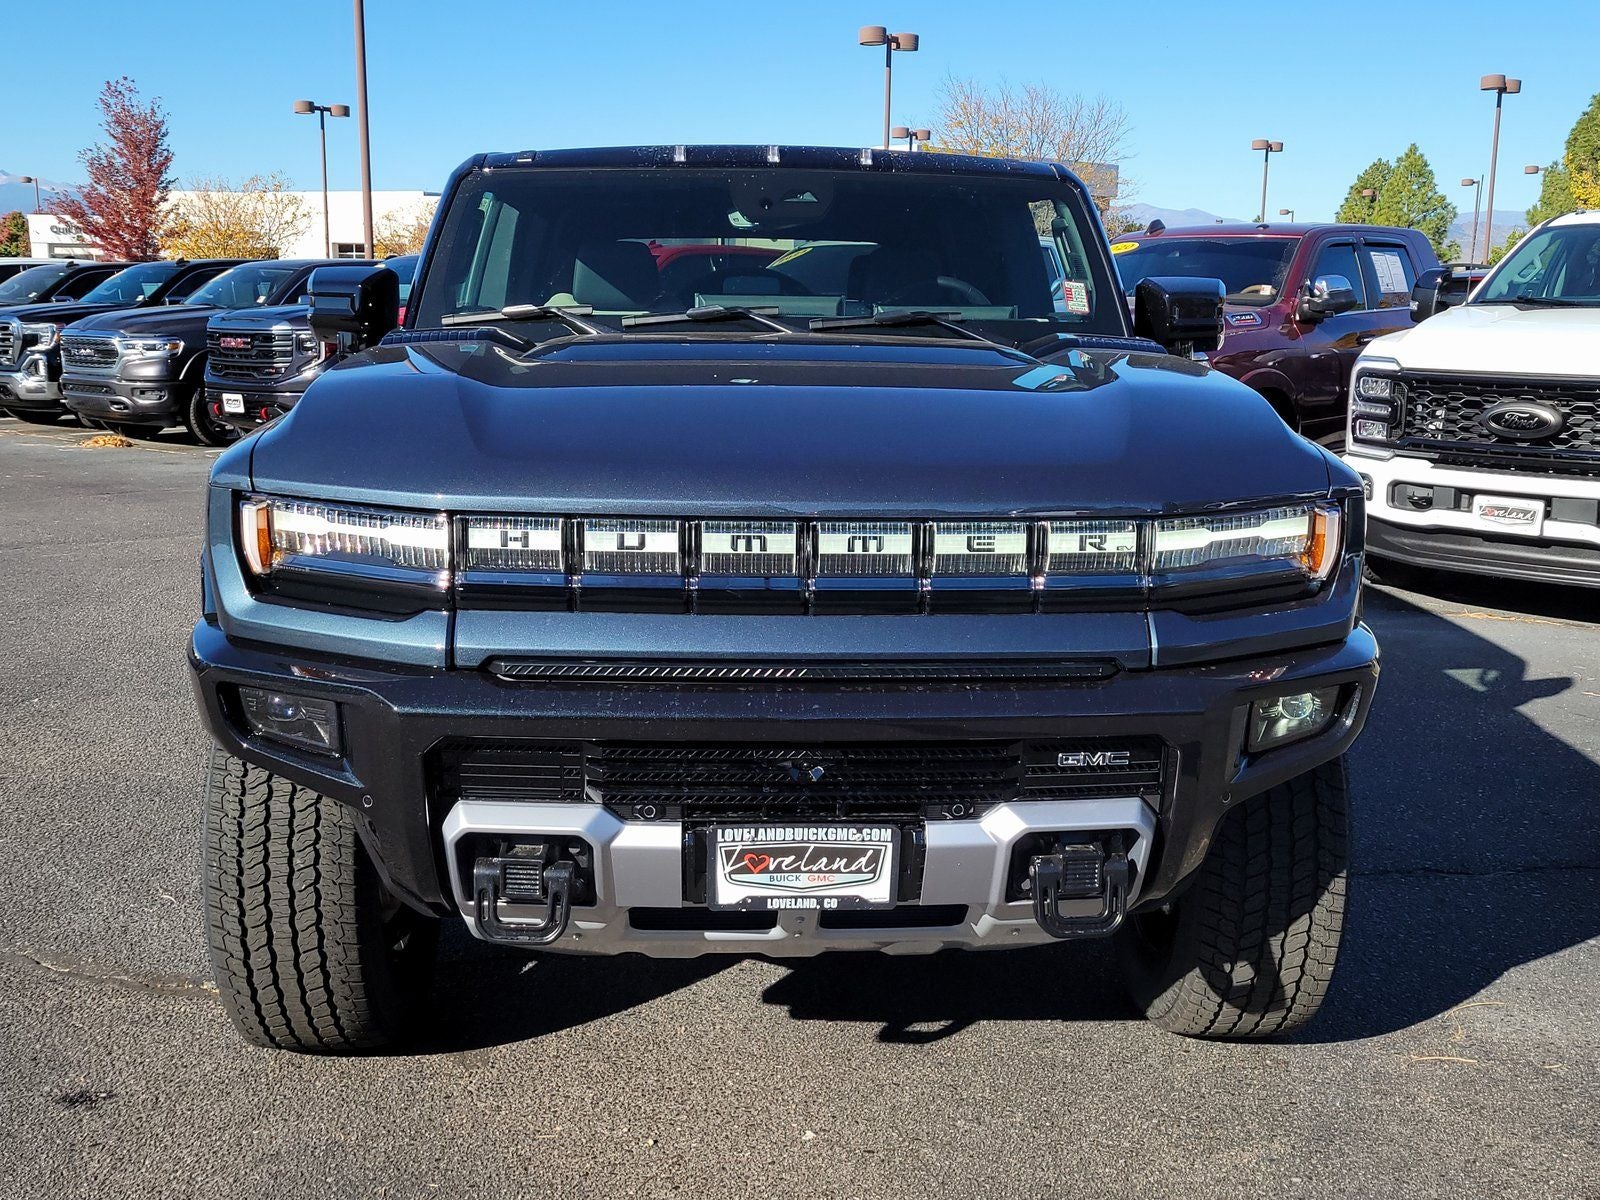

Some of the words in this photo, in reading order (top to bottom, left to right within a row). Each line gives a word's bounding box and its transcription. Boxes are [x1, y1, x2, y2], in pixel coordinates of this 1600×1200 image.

[1501, 411, 1539, 429] Ford
[500, 529, 1107, 553] HUMMER
[1057, 751, 1130, 766] GMC
[716, 827, 892, 842] LOVELANDBUICKGMCCOM
[723, 844, 876, 875] Loveland
[769, 874, 801, 883] BUICK
[807, 874, 836, 883] GMC
[767, 898, 821, 909] LOVELAND,
[824, 898, 838, 909] CO
